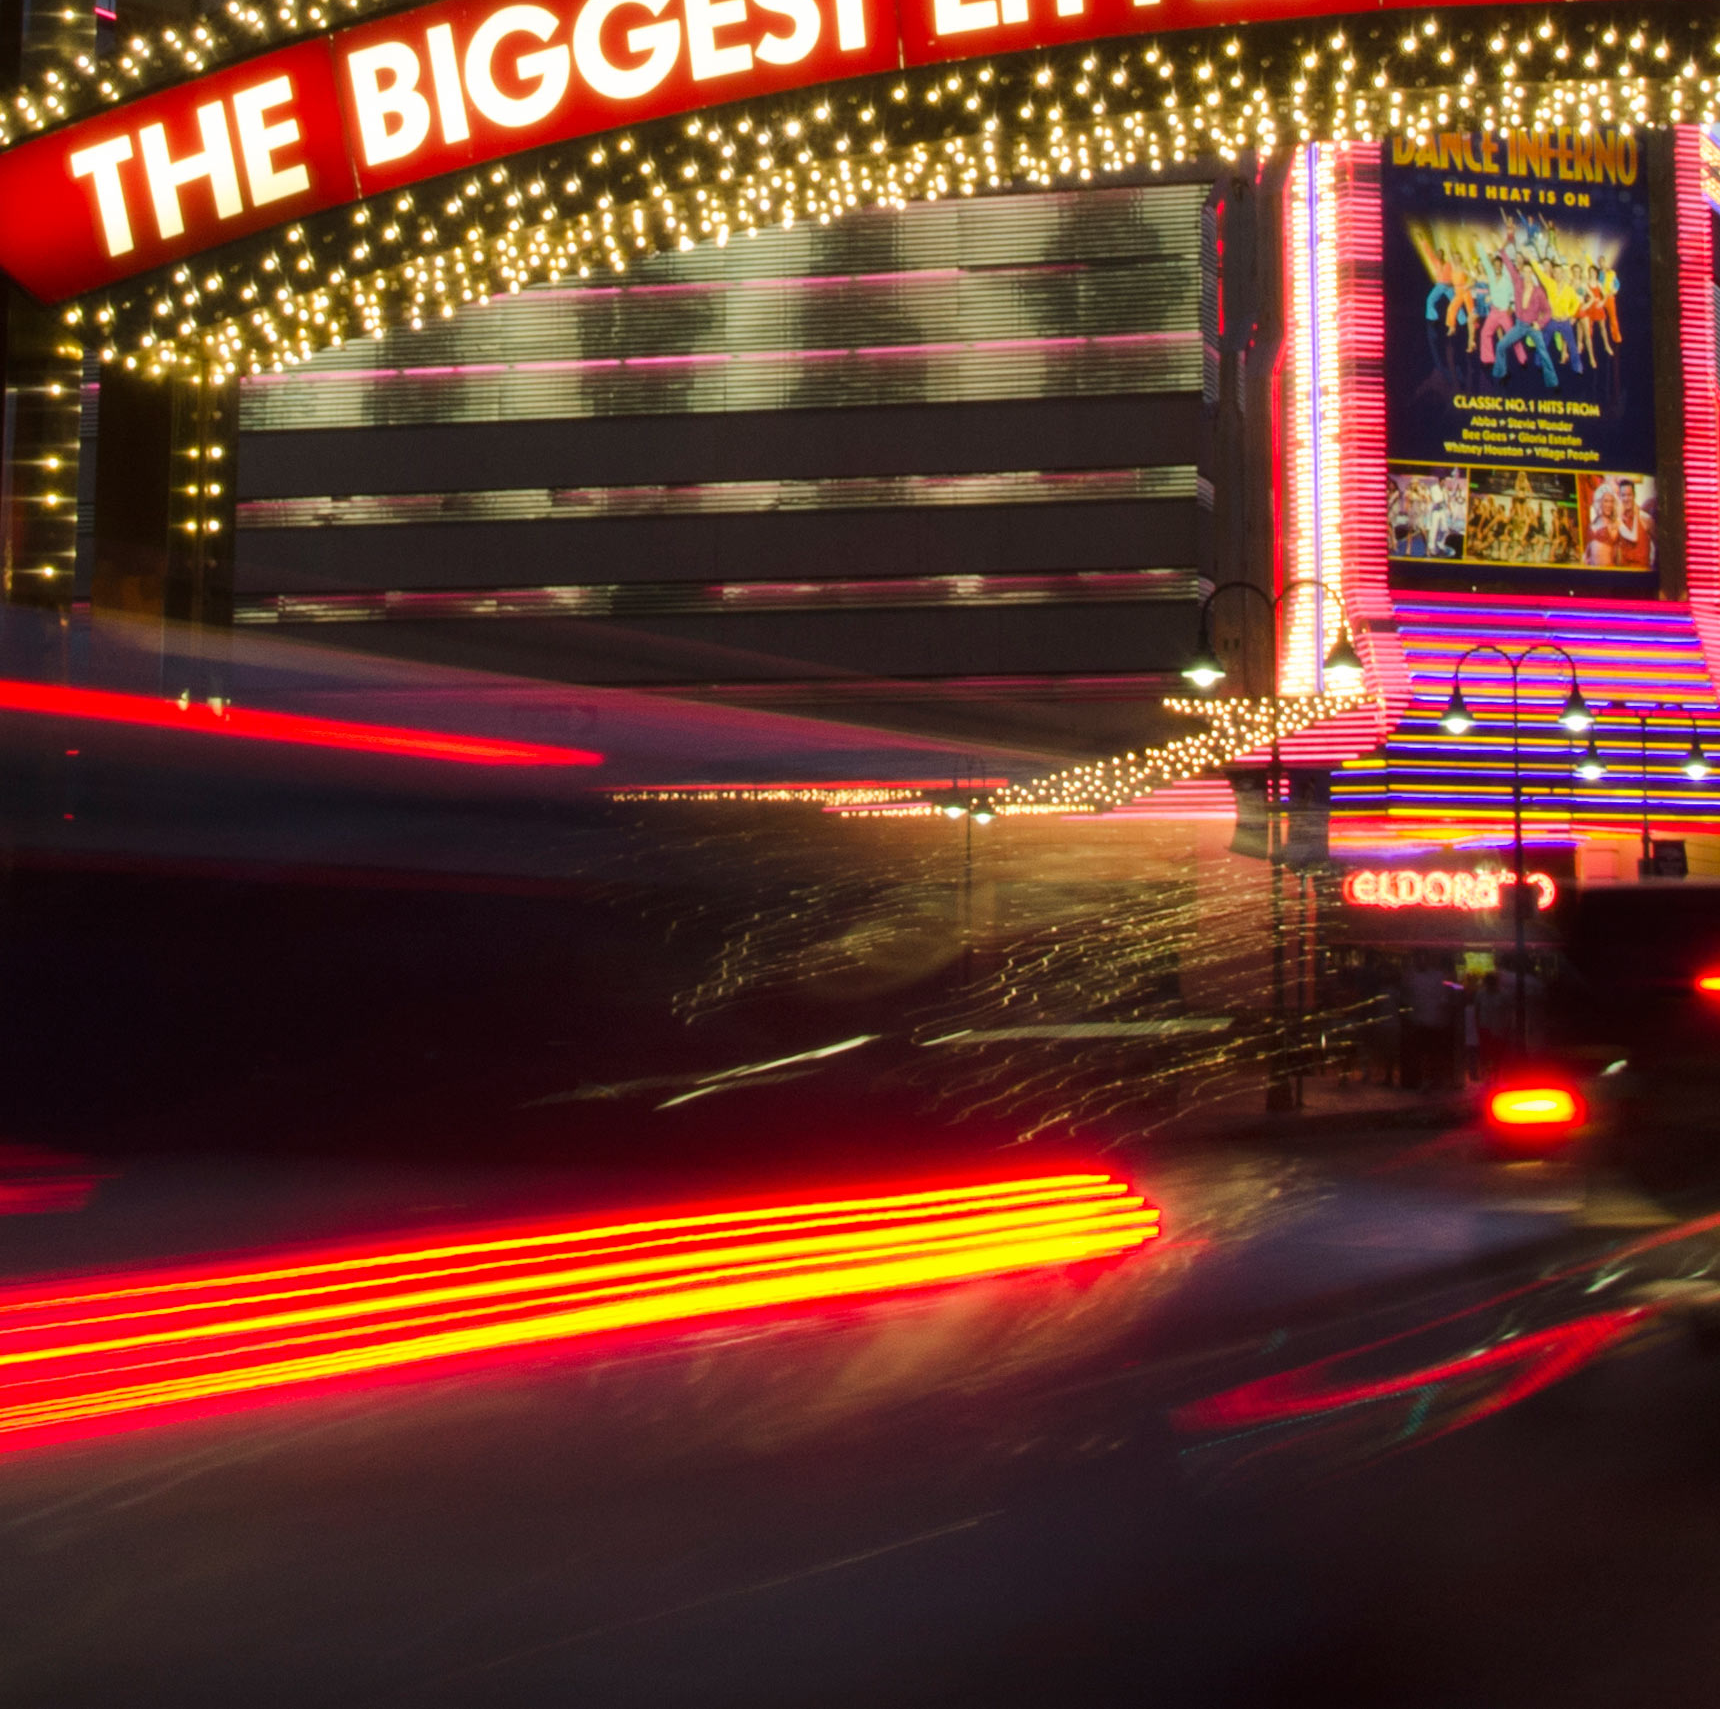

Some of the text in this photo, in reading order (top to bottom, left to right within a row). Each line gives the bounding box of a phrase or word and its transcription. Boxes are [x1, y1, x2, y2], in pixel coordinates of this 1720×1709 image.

[69, 76, 310, 257] THE
[1392, 127, 1638, 186] DANCE INFERNO
[1443, 181, 1591, 208] THE HEAT IS ON
[1452, 394, 1504, 411] CLASSIC
[1537, 399, 1565, 415] HITS
[1565, 400, 1601, 417] FROM
[1470, 415, 1574, 432] Abba Stevie Wonder
[1461, 428, 1583, 447] Bee Gees Gloria Estefan
[1443, 441, 1601, 463] Whitney Houston Village People
